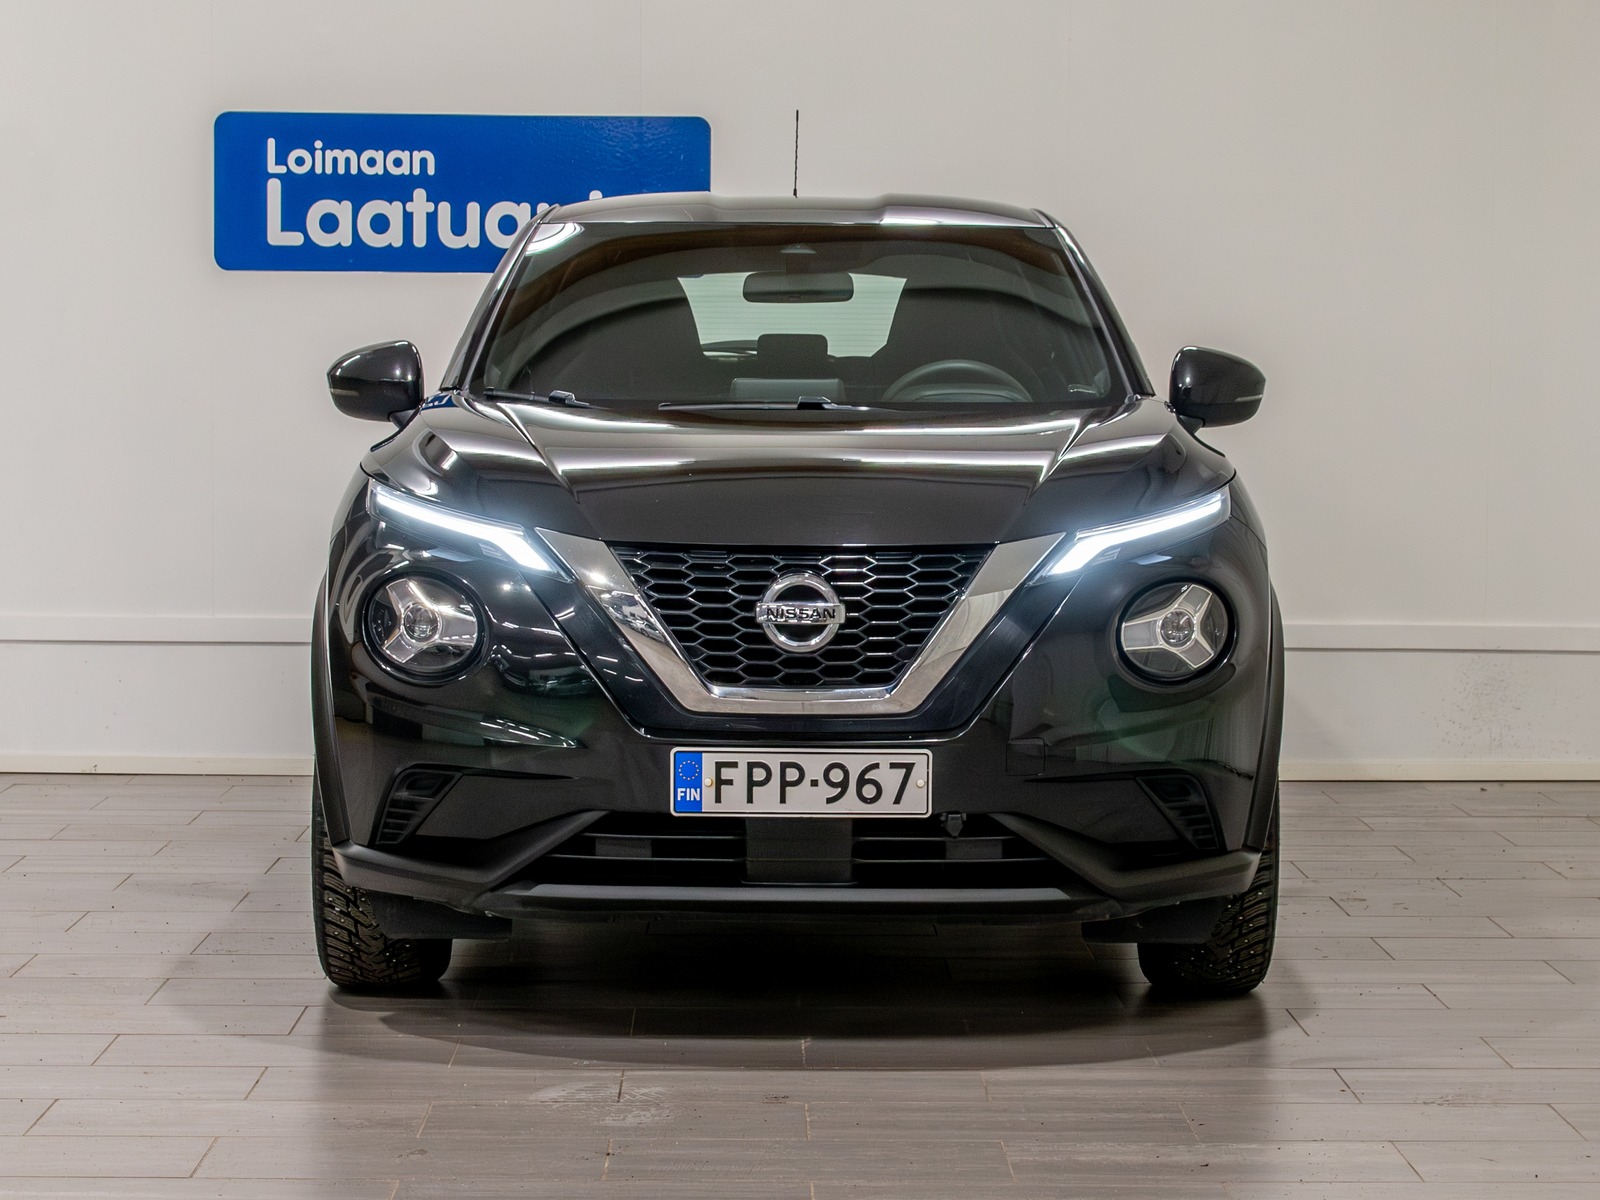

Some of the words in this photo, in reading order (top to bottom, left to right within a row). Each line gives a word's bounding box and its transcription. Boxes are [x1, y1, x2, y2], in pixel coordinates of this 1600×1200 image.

[266, 137, 436, 175] Loimaan
[266, 177, 603, 249] Laatua
[766, 608, 836, 619] NISSAN
[677, 788, 700, 801] FIN
[714, 760, 916, 805] FPP-967
